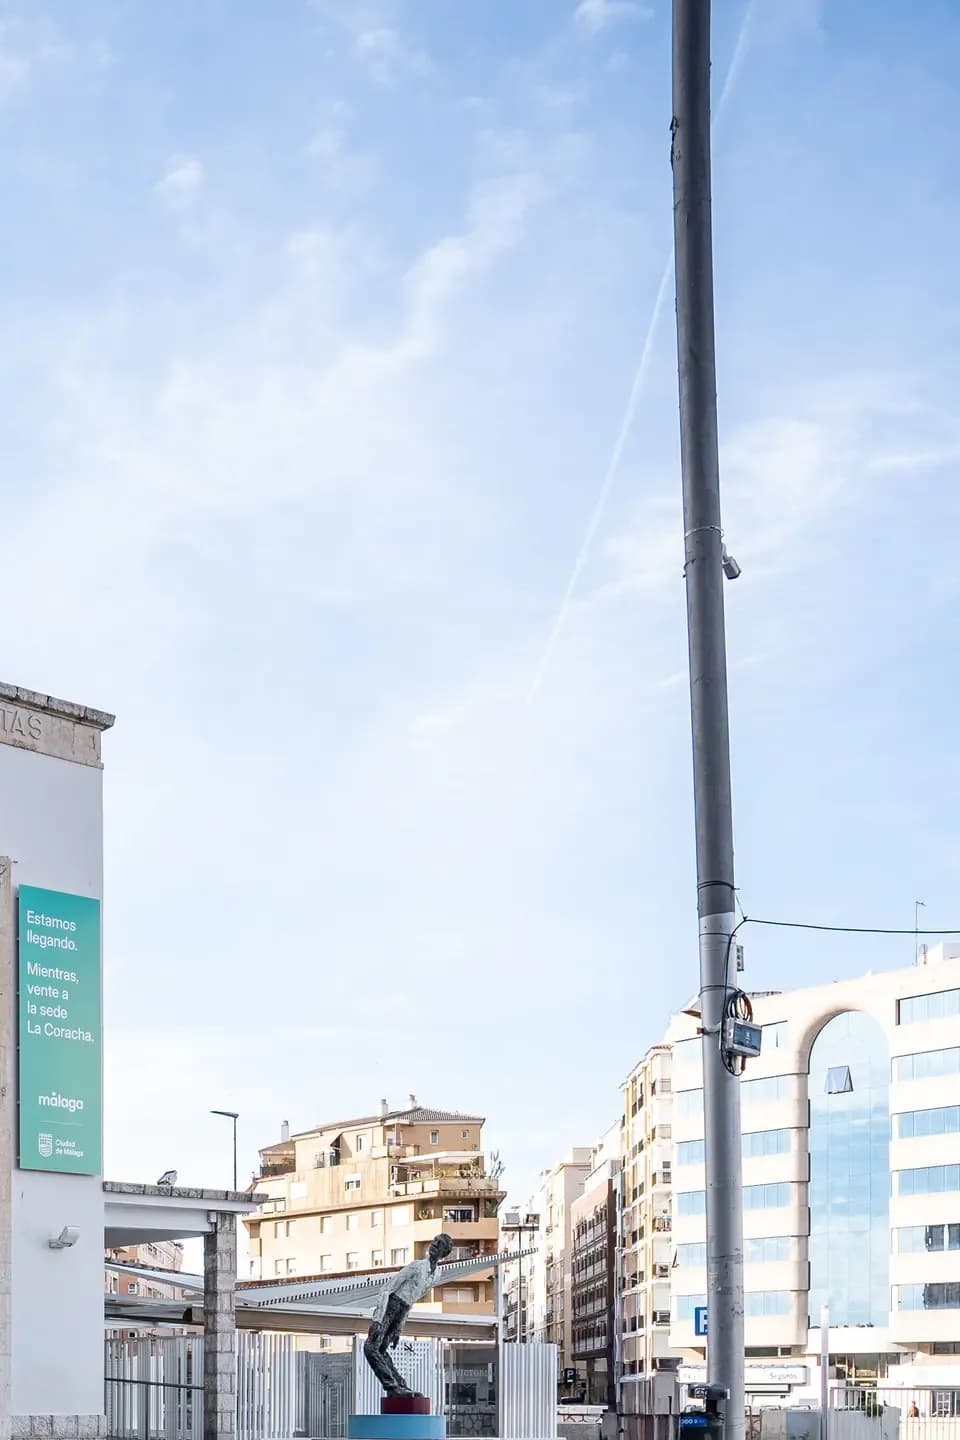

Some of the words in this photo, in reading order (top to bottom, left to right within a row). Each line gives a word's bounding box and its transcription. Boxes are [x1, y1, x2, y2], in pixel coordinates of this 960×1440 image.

[27, 911, 76, 931] Estamos
[27, 929, 78, 951] llegando.
[27, 962, 79, 984] Mientras,
[27, 984, 59, 998] vente
[62, 990, 68, 1000] a
[28, 1000, 37, 1014] la
[40, 1005, 67, 1019] sede
[28, 1020, 41, 1034] La
[44, 1022, 95, 1043] Coracha.
[567, 1370, 575, 1378] P
